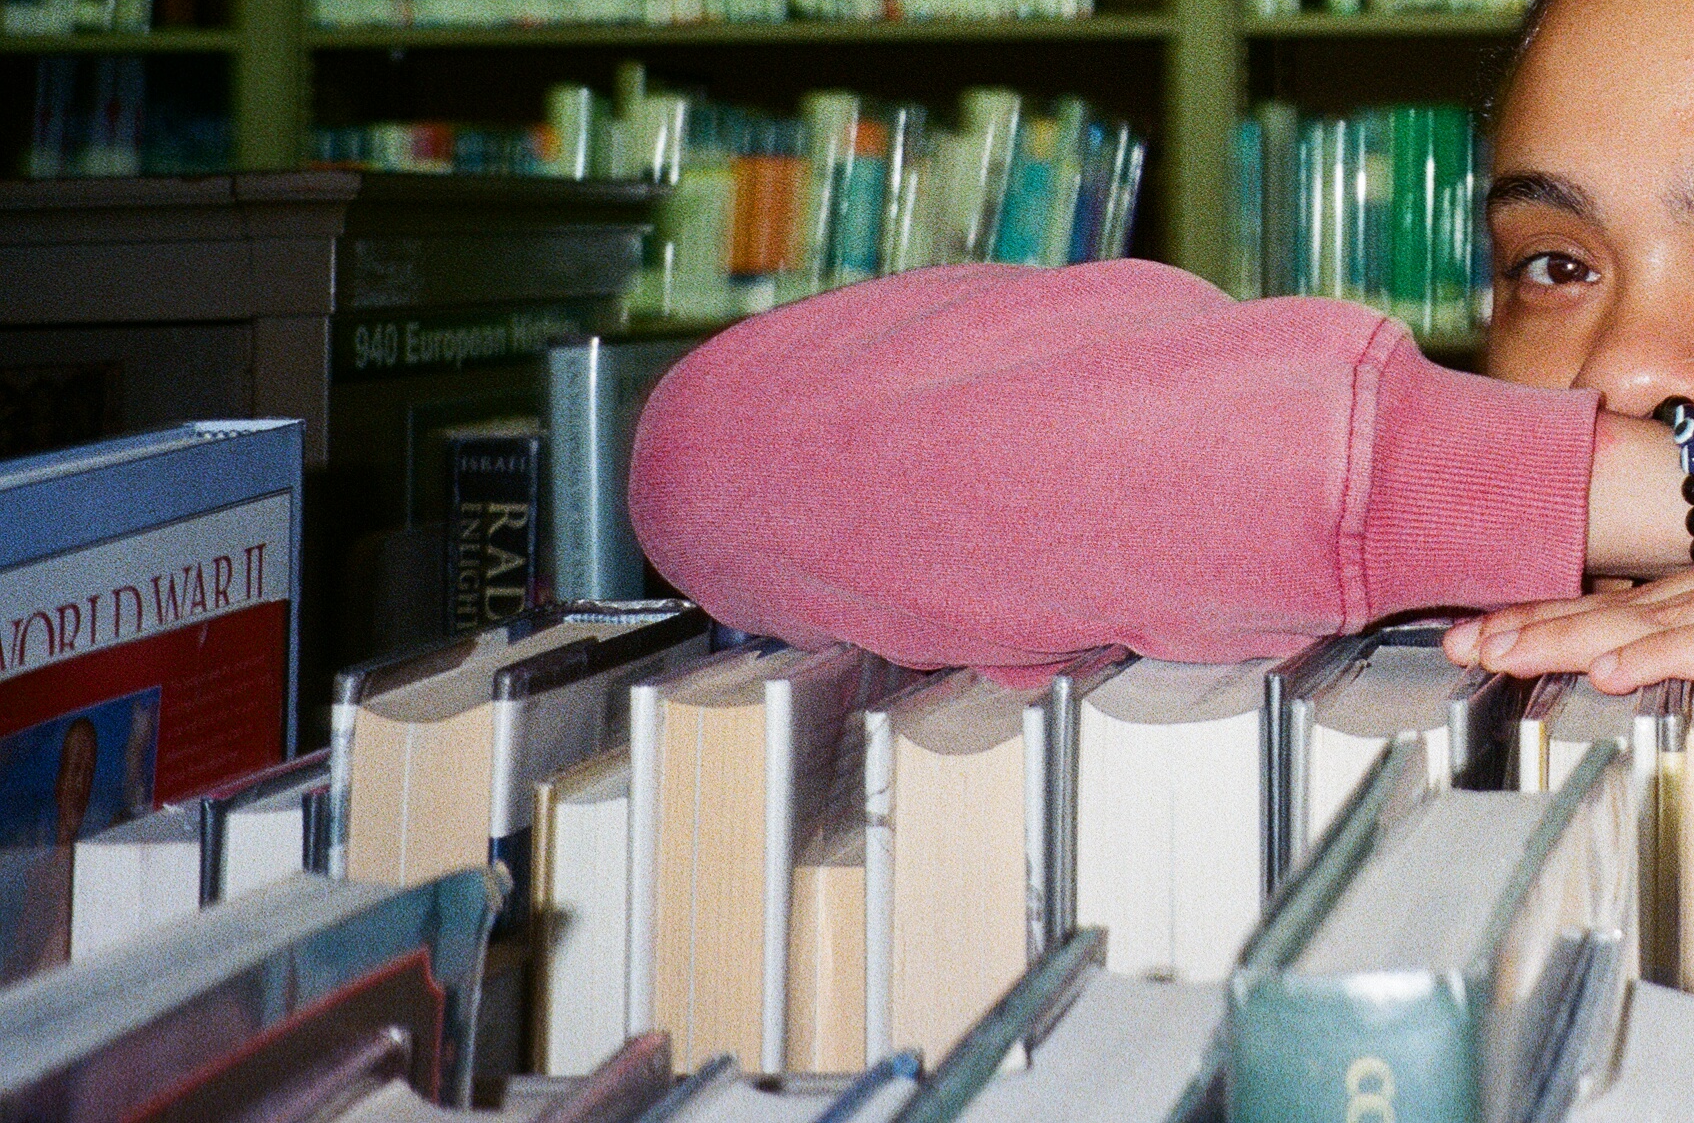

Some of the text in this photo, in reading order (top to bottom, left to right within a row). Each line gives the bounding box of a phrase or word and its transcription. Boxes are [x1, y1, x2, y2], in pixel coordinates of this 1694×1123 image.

[355, 323, 398, 370] 940
[405, 321, 506, 370] European
[151, 555, 233, 625] WAR
[244, 542, 267, 600] II
